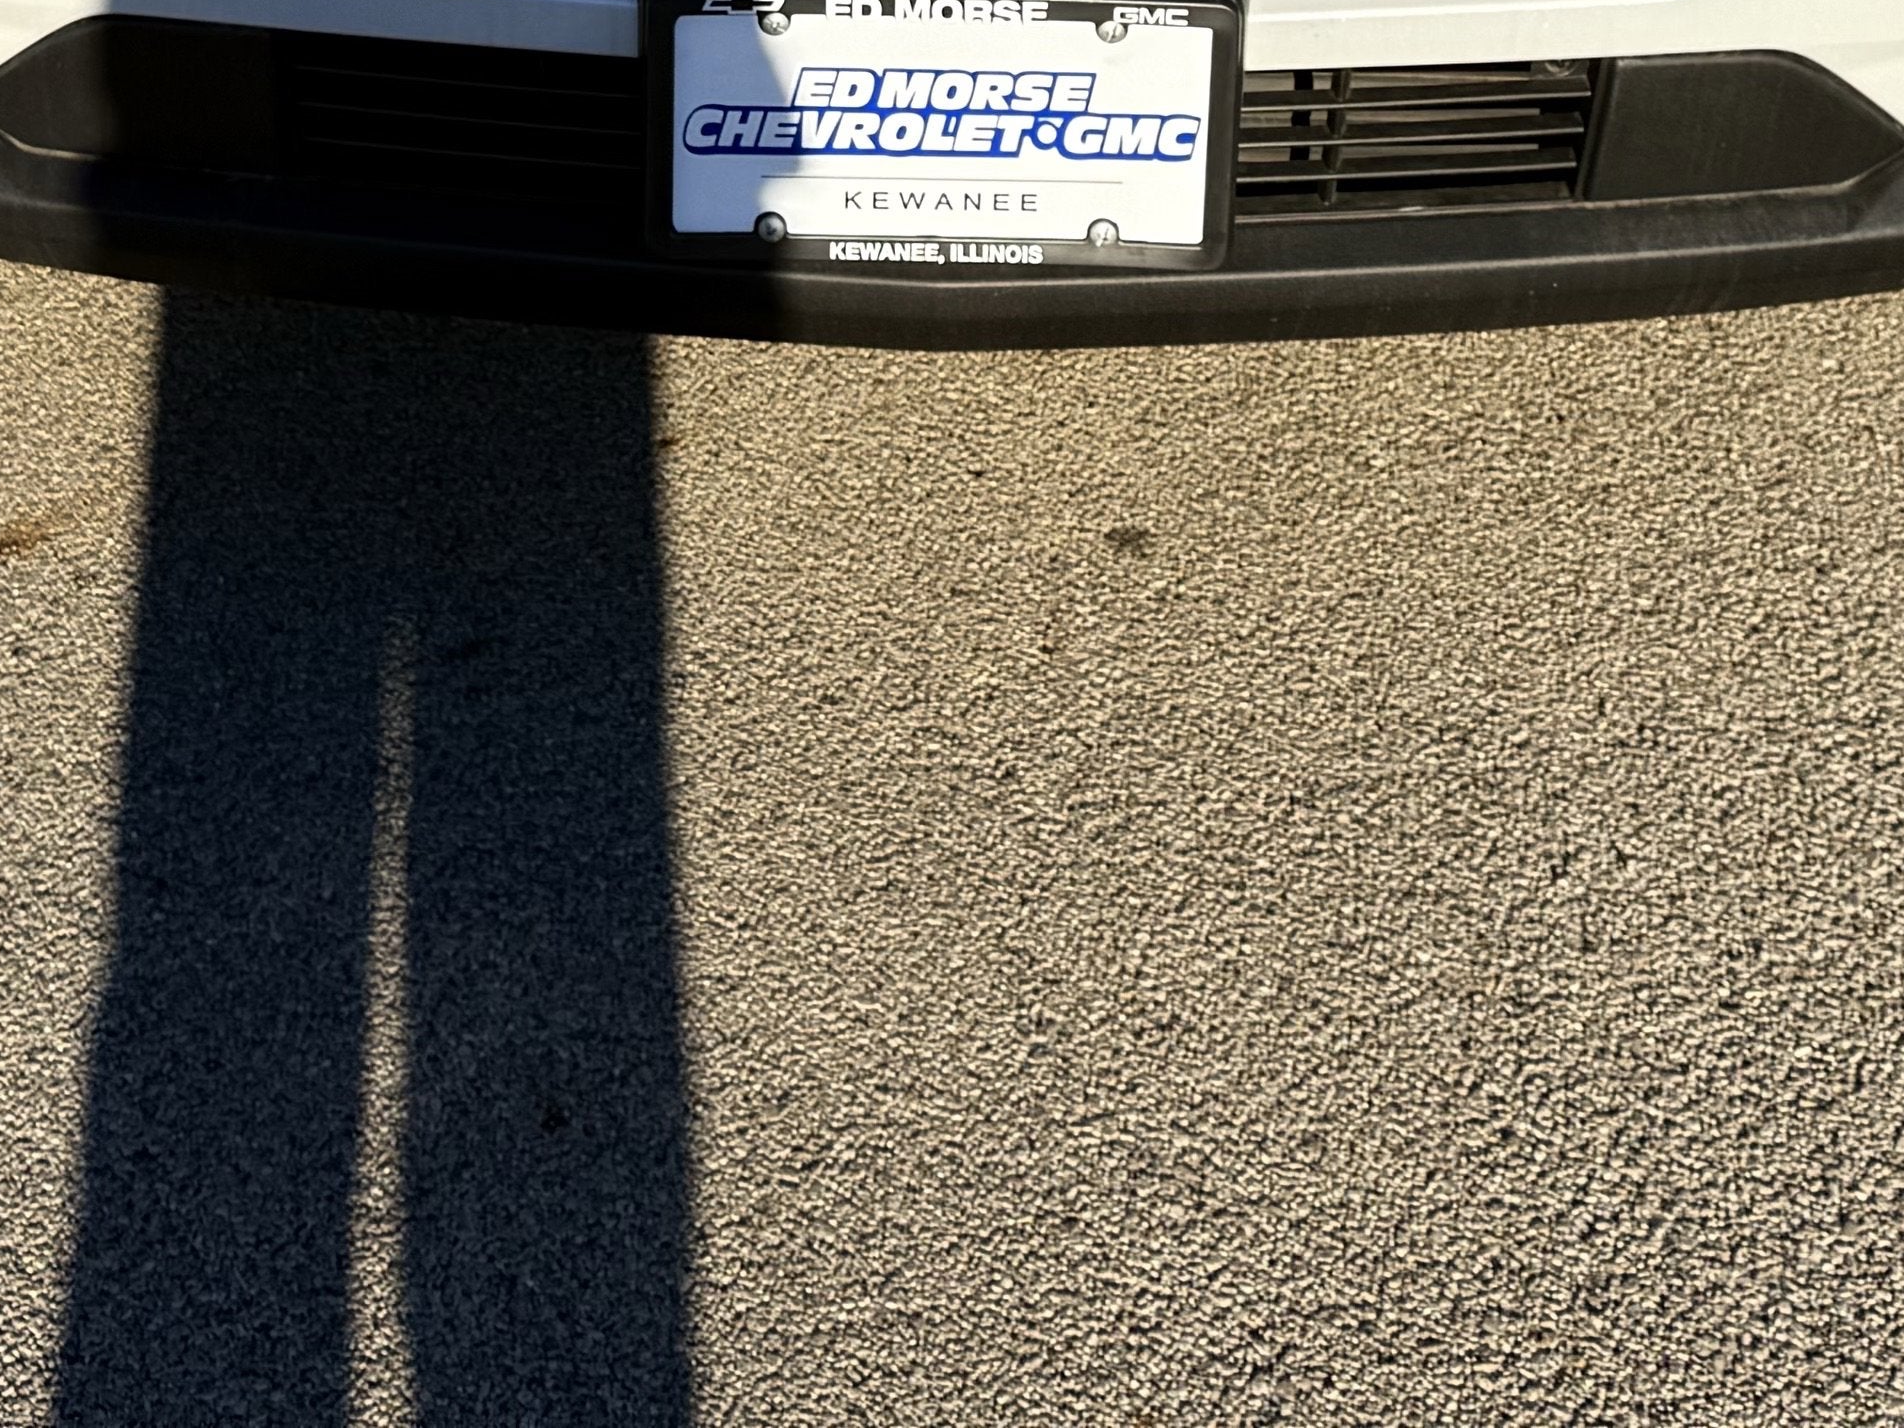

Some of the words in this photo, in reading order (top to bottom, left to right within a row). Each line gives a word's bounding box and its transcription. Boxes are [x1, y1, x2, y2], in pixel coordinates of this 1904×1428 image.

[1112, 6, 1190, 26] GMC
[792, 69, 876, 108] ED
[876, 70, 1095, 112] MORSE
[844, 191, 1038, 212] KEWANEE
[829, 241, 946, 265] KEWANEE,
[949, 242, 1044, 265] ILLINOIS
